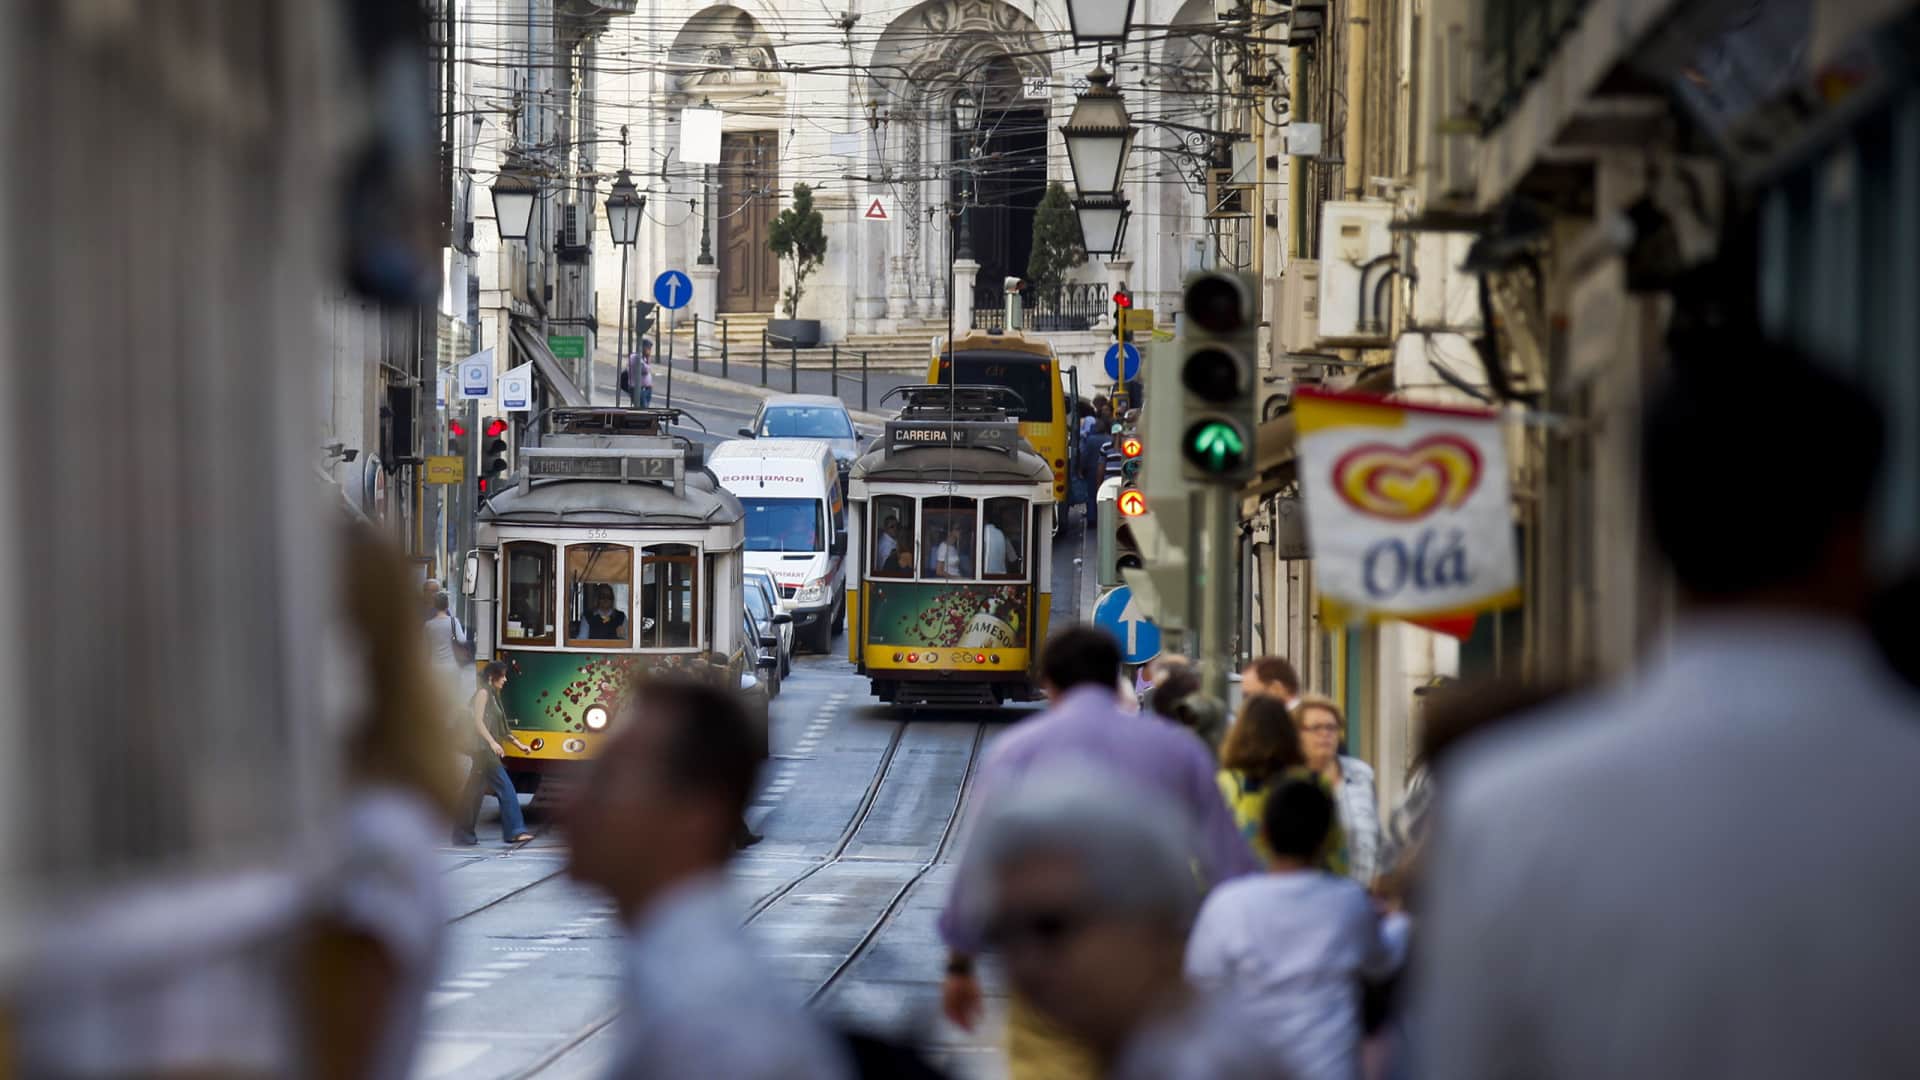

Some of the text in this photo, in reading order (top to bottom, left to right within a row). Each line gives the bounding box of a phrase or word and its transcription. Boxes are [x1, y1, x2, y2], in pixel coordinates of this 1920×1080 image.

[896, 430, 947, 441] CARREIRA
[639, 458, 664, 476] 12
[588, 528, 608, 539] 556
[1363, 527, 1470, 601] Olá
